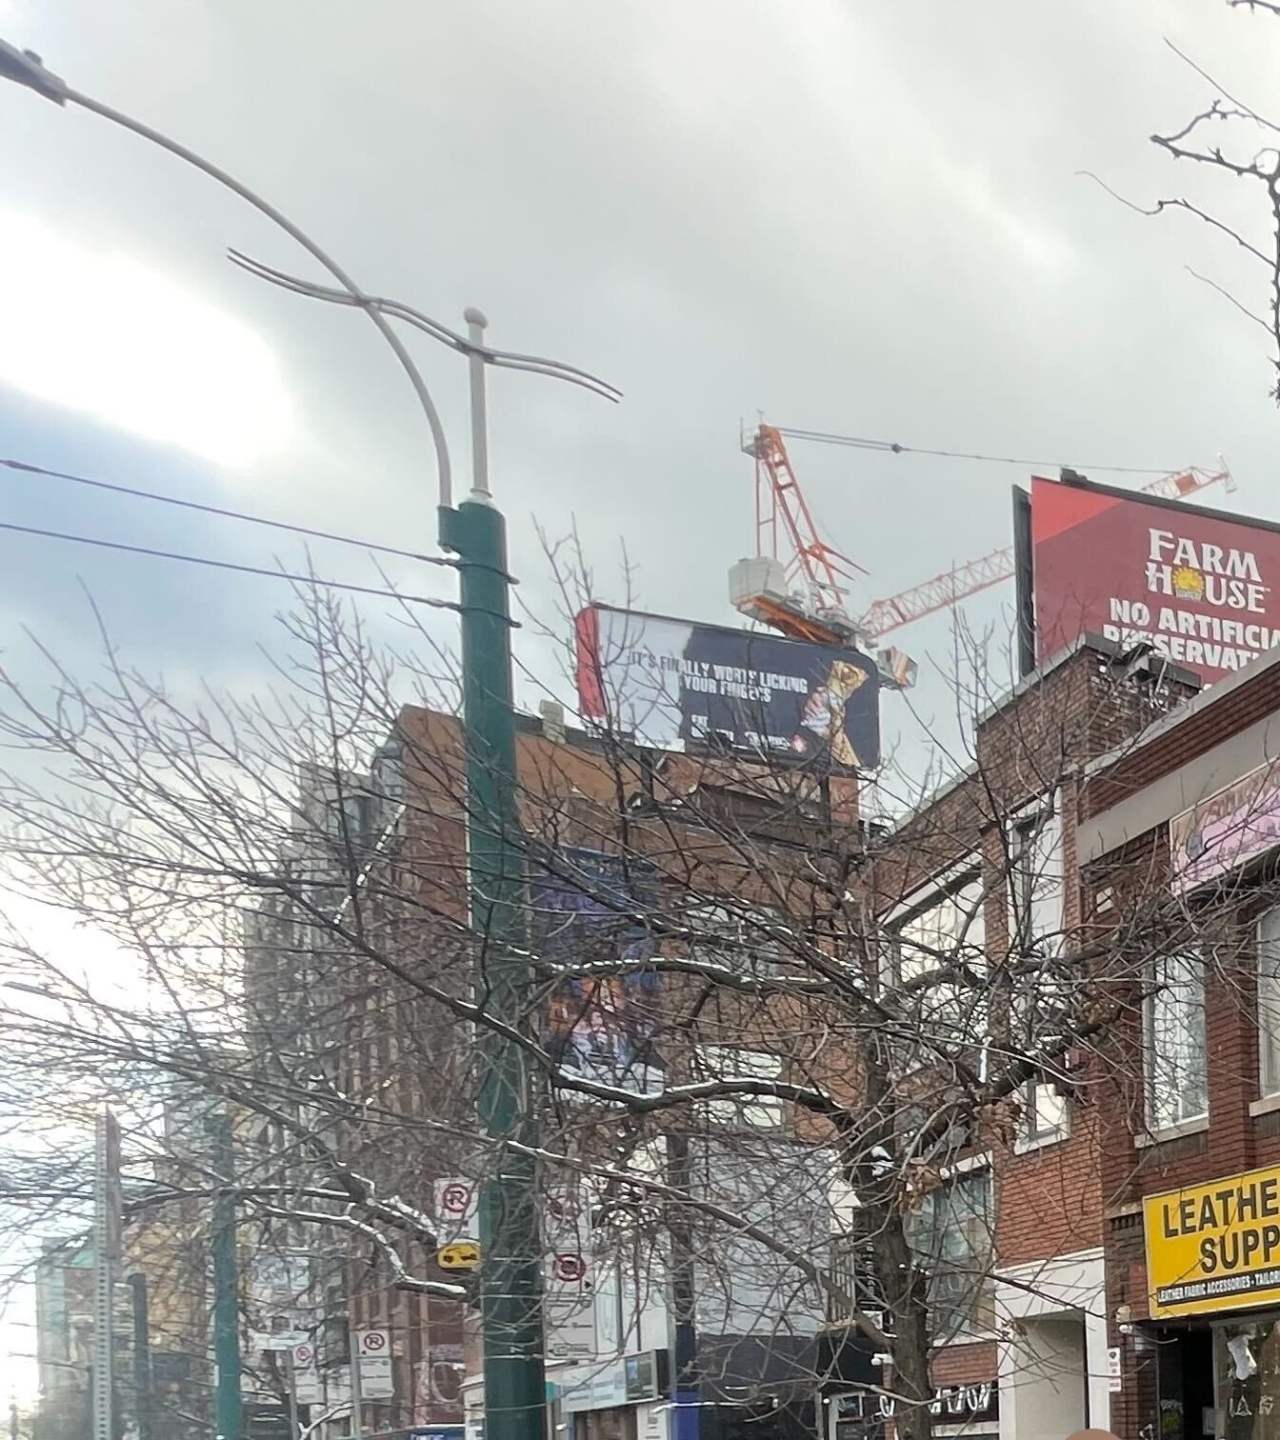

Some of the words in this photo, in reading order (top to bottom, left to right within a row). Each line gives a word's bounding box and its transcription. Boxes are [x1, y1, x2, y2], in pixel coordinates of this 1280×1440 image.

[1149, 528, 1263, 582] FARM
[1145, 562, 1266, 614] HOUSE
[1110, 598, 1150, 627] NO
[660, 656, 710, 678] FINALLY
[759, 672, 808, 694] LICKING
[683, 675, 716, 695] YOUR
[1185, 1283, 1206, 1298] FABRIC
[1207, 1275, 1250, 1295] ACCESSORIES
